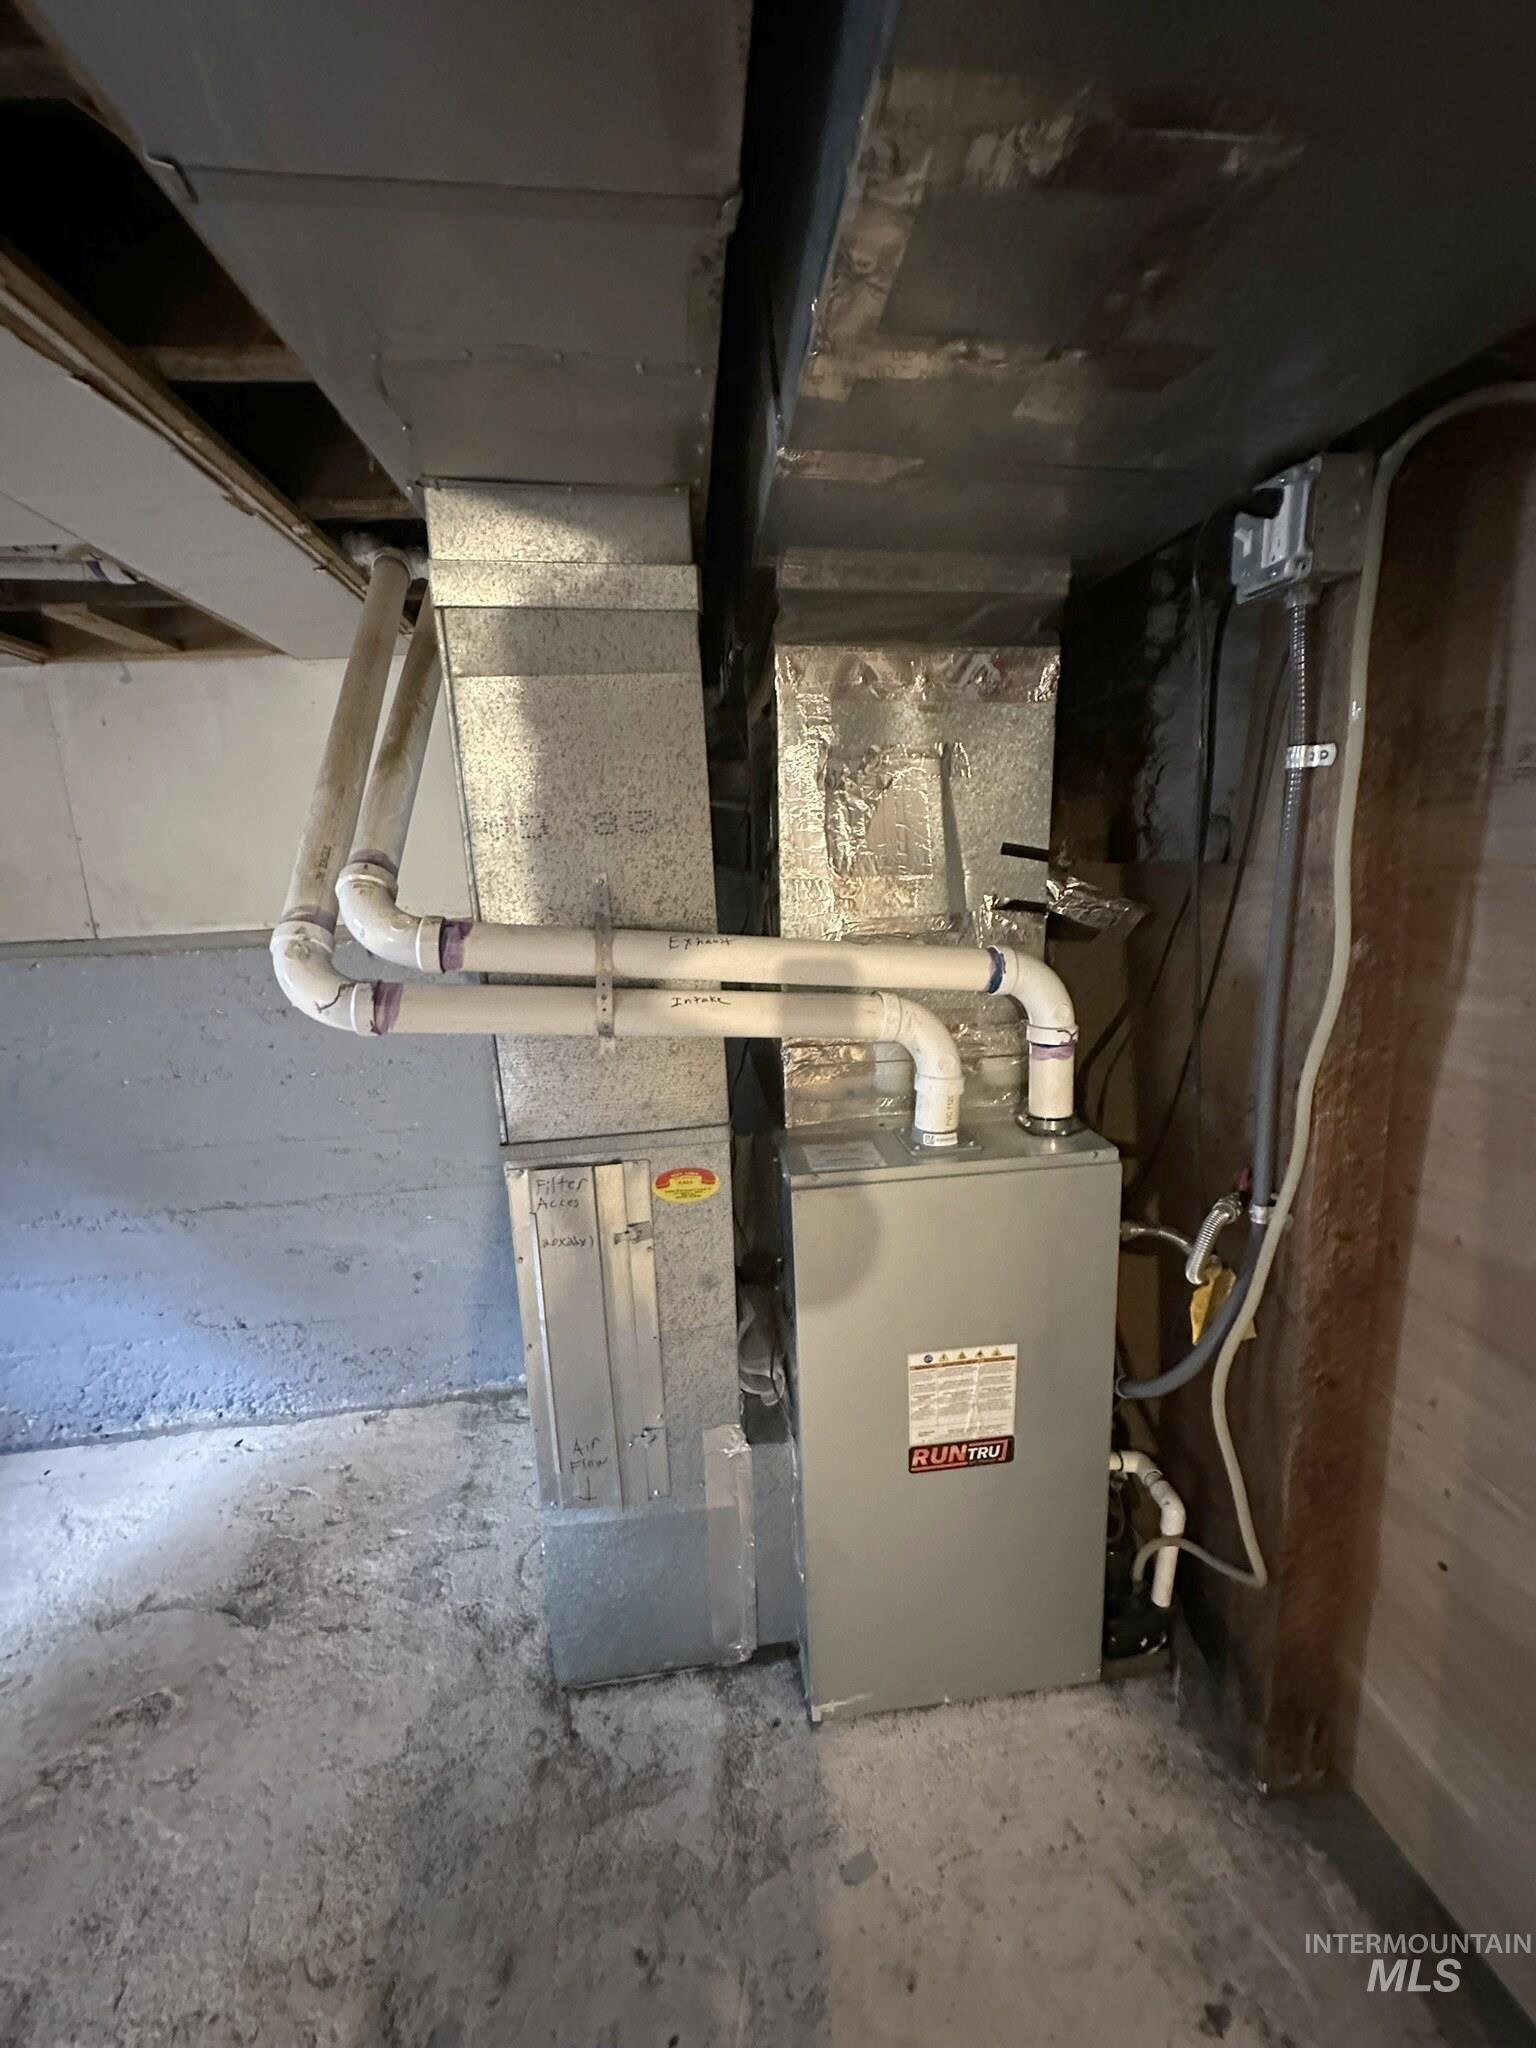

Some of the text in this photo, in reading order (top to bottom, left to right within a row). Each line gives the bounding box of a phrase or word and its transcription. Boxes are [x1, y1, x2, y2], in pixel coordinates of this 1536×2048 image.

[671, 996, 731, 1008] Intake
[536, 1176, 588, 1195] Filter
[573, 1438, 600, 1457] Air
